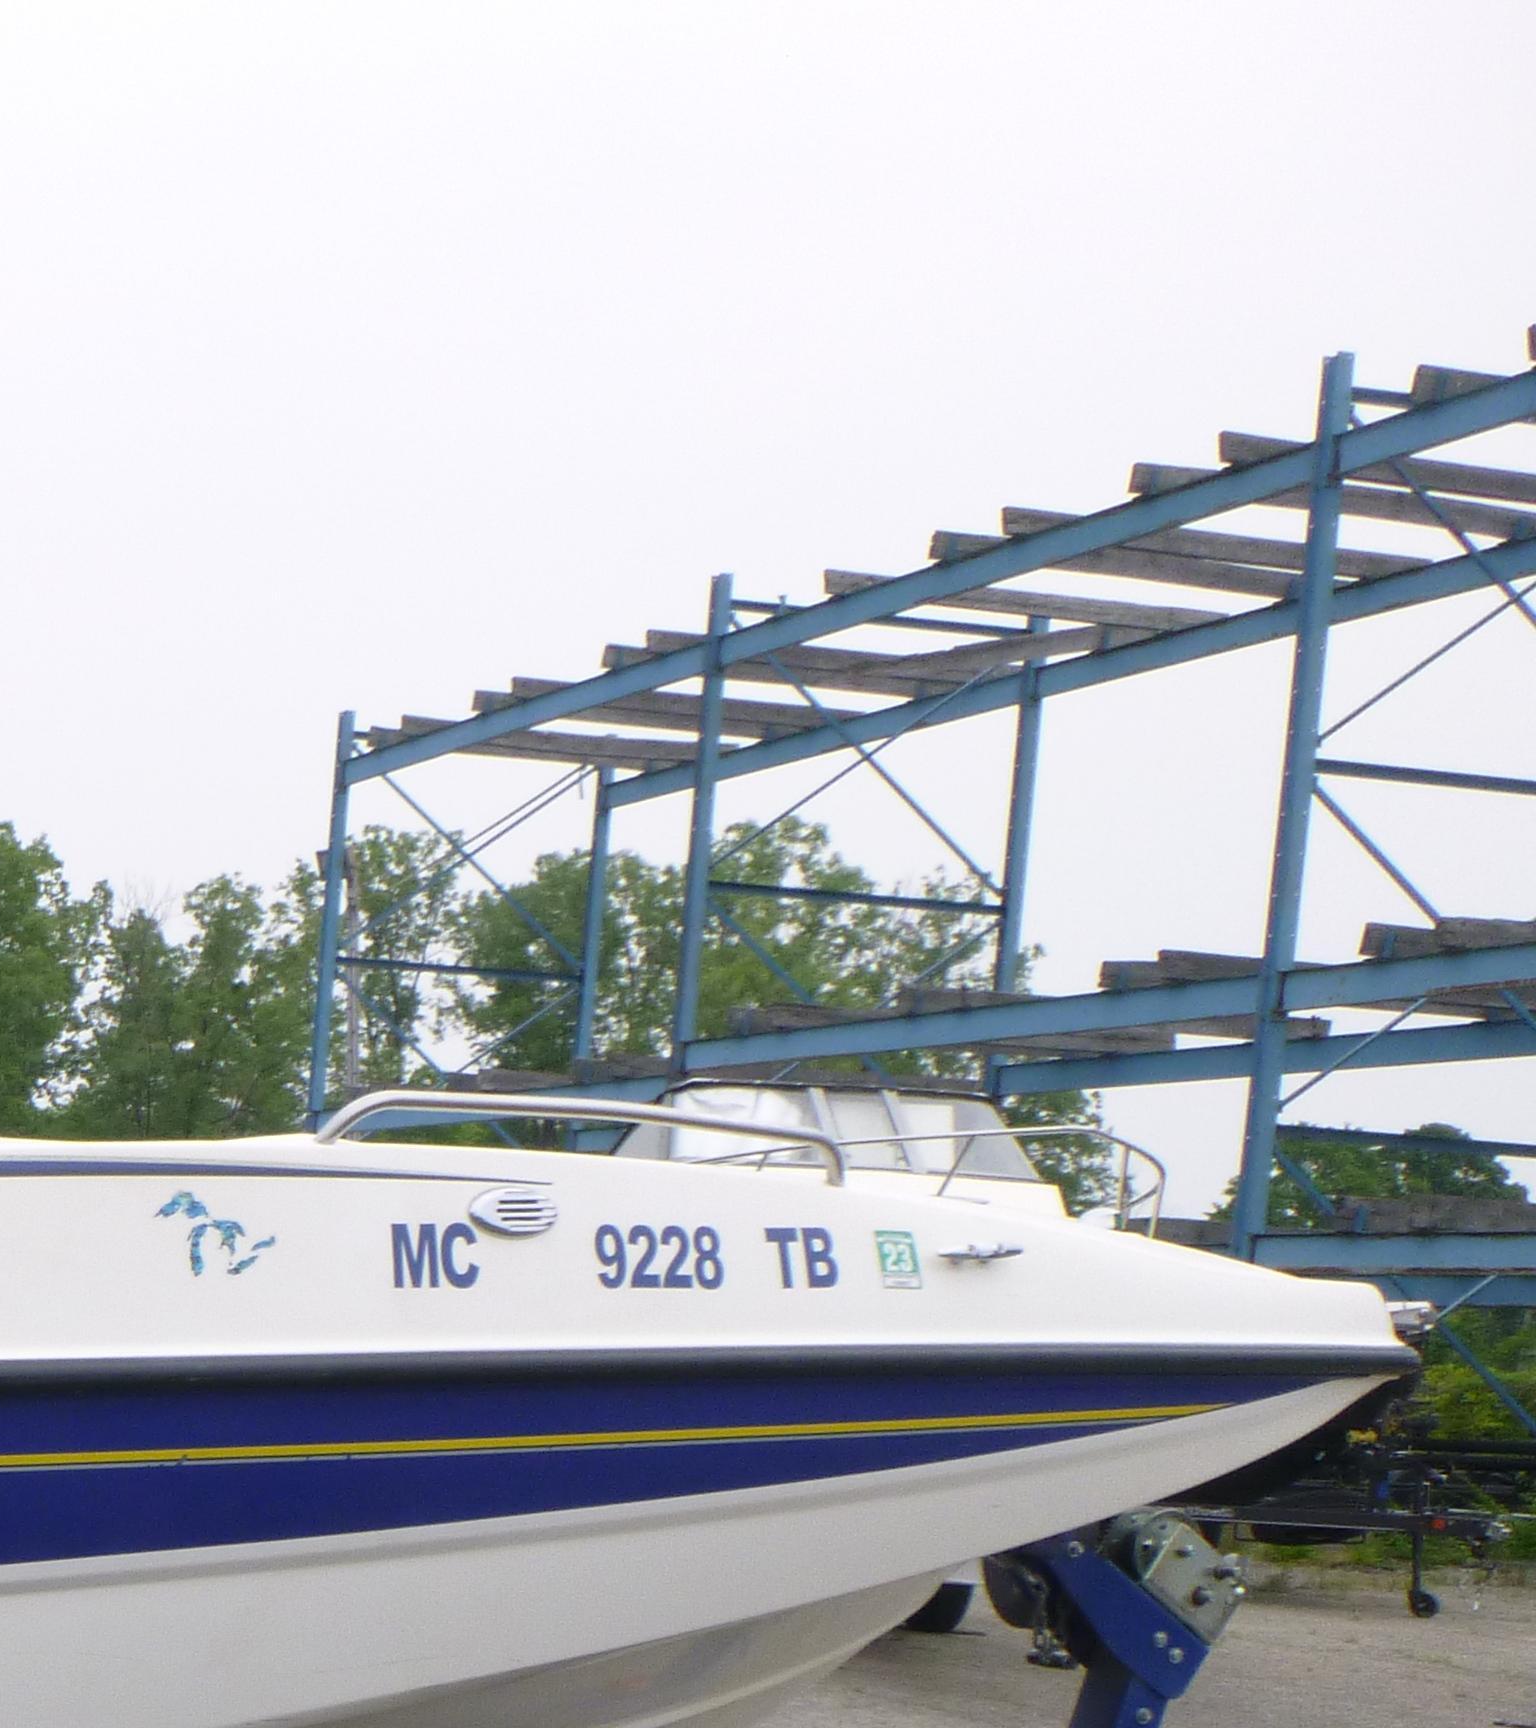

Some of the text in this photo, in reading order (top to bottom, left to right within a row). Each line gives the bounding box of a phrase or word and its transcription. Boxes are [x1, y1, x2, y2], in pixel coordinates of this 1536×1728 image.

[391, 1223, 839, 1290] MC 9228 TB
[883, 1241, 914, 1273] 23
